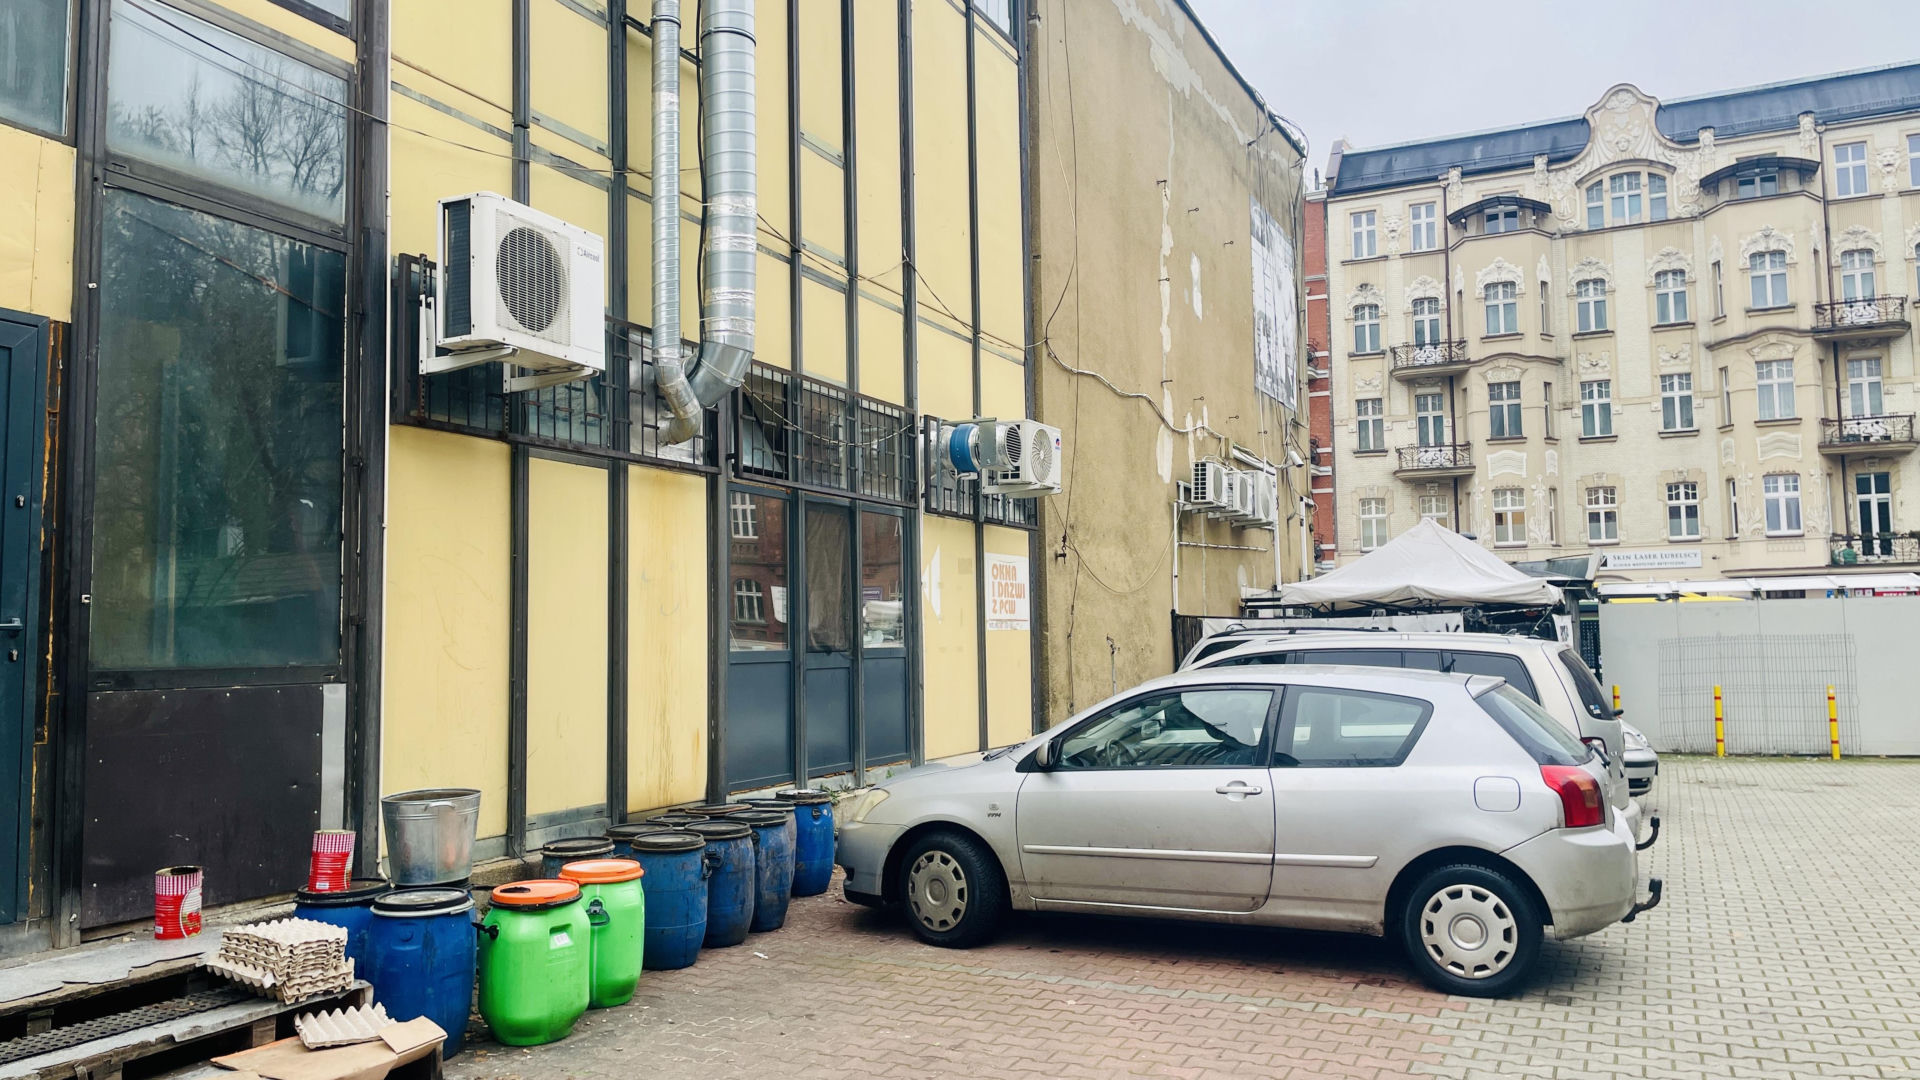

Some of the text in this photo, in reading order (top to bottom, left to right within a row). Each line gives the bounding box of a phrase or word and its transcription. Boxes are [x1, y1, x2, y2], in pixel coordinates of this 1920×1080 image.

[1660, 551, 1698, 559] LUBELSCY
[991, 563, 1017, 581] OKNA
[992, 581, 1026, 599] I DRZWI
[992, 598, 1016, 614] Z PCW
